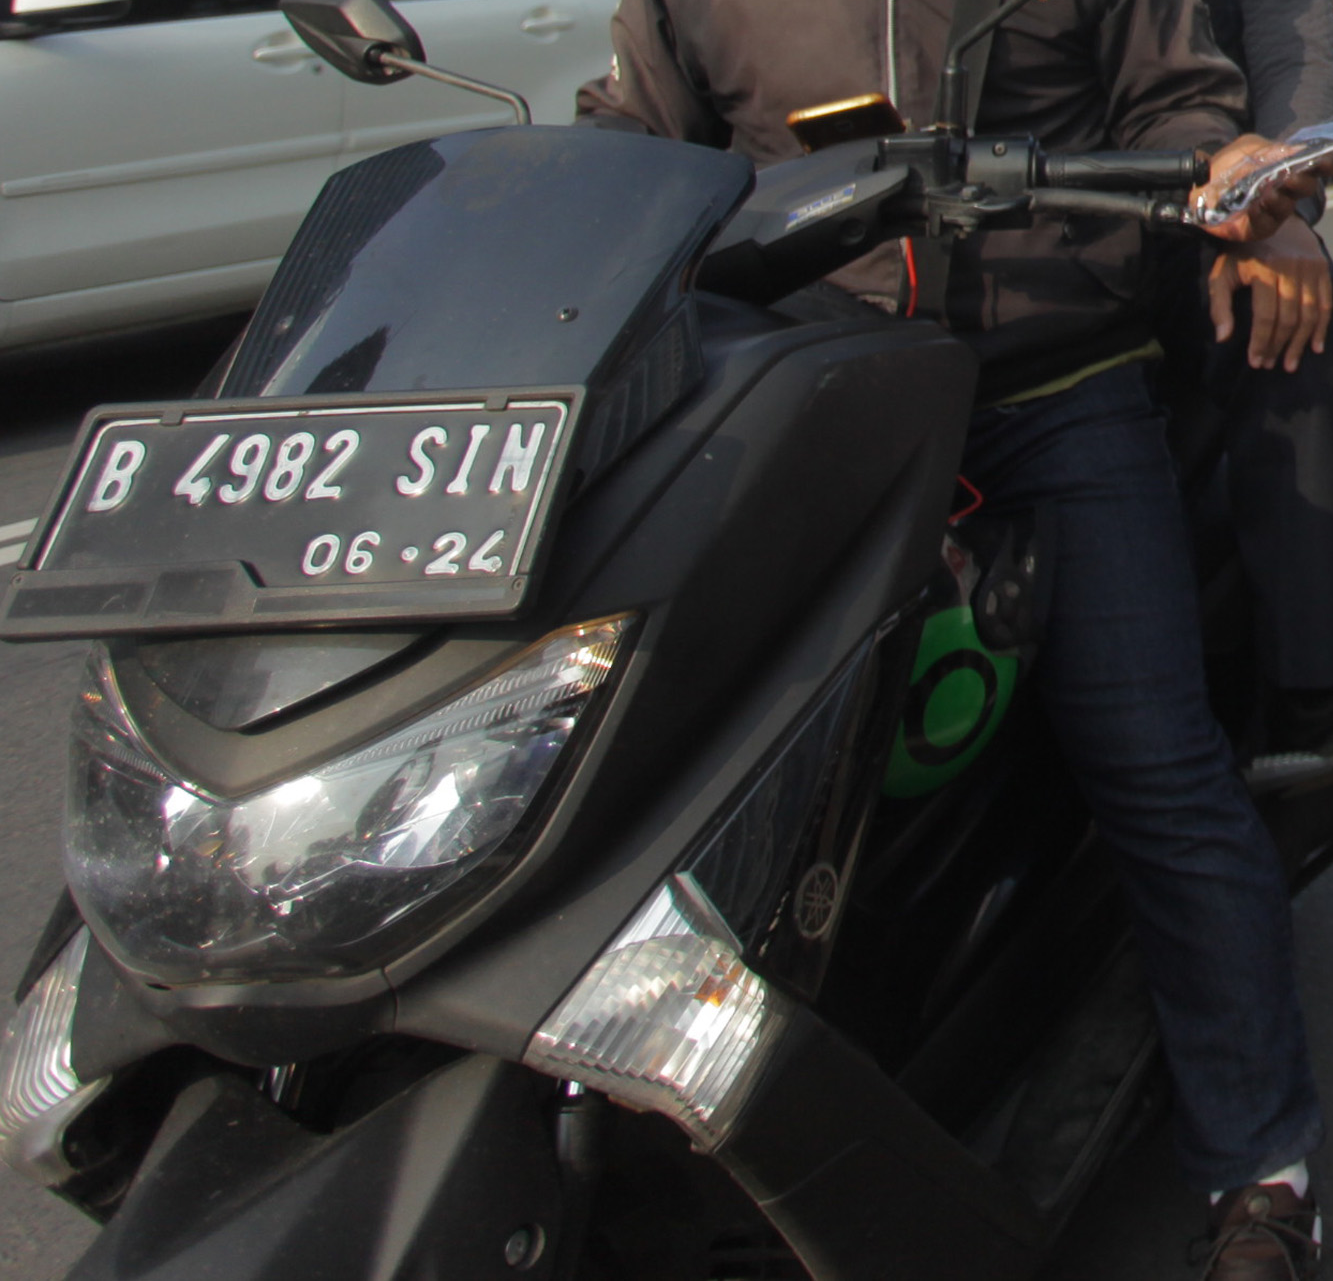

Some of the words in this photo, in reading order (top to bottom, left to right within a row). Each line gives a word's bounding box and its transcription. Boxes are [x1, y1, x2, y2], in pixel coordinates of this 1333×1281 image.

[87, 440, 146, 512] B
[173, 429, 361, 506] 4982
[396, 422, 546, 496] SIN
